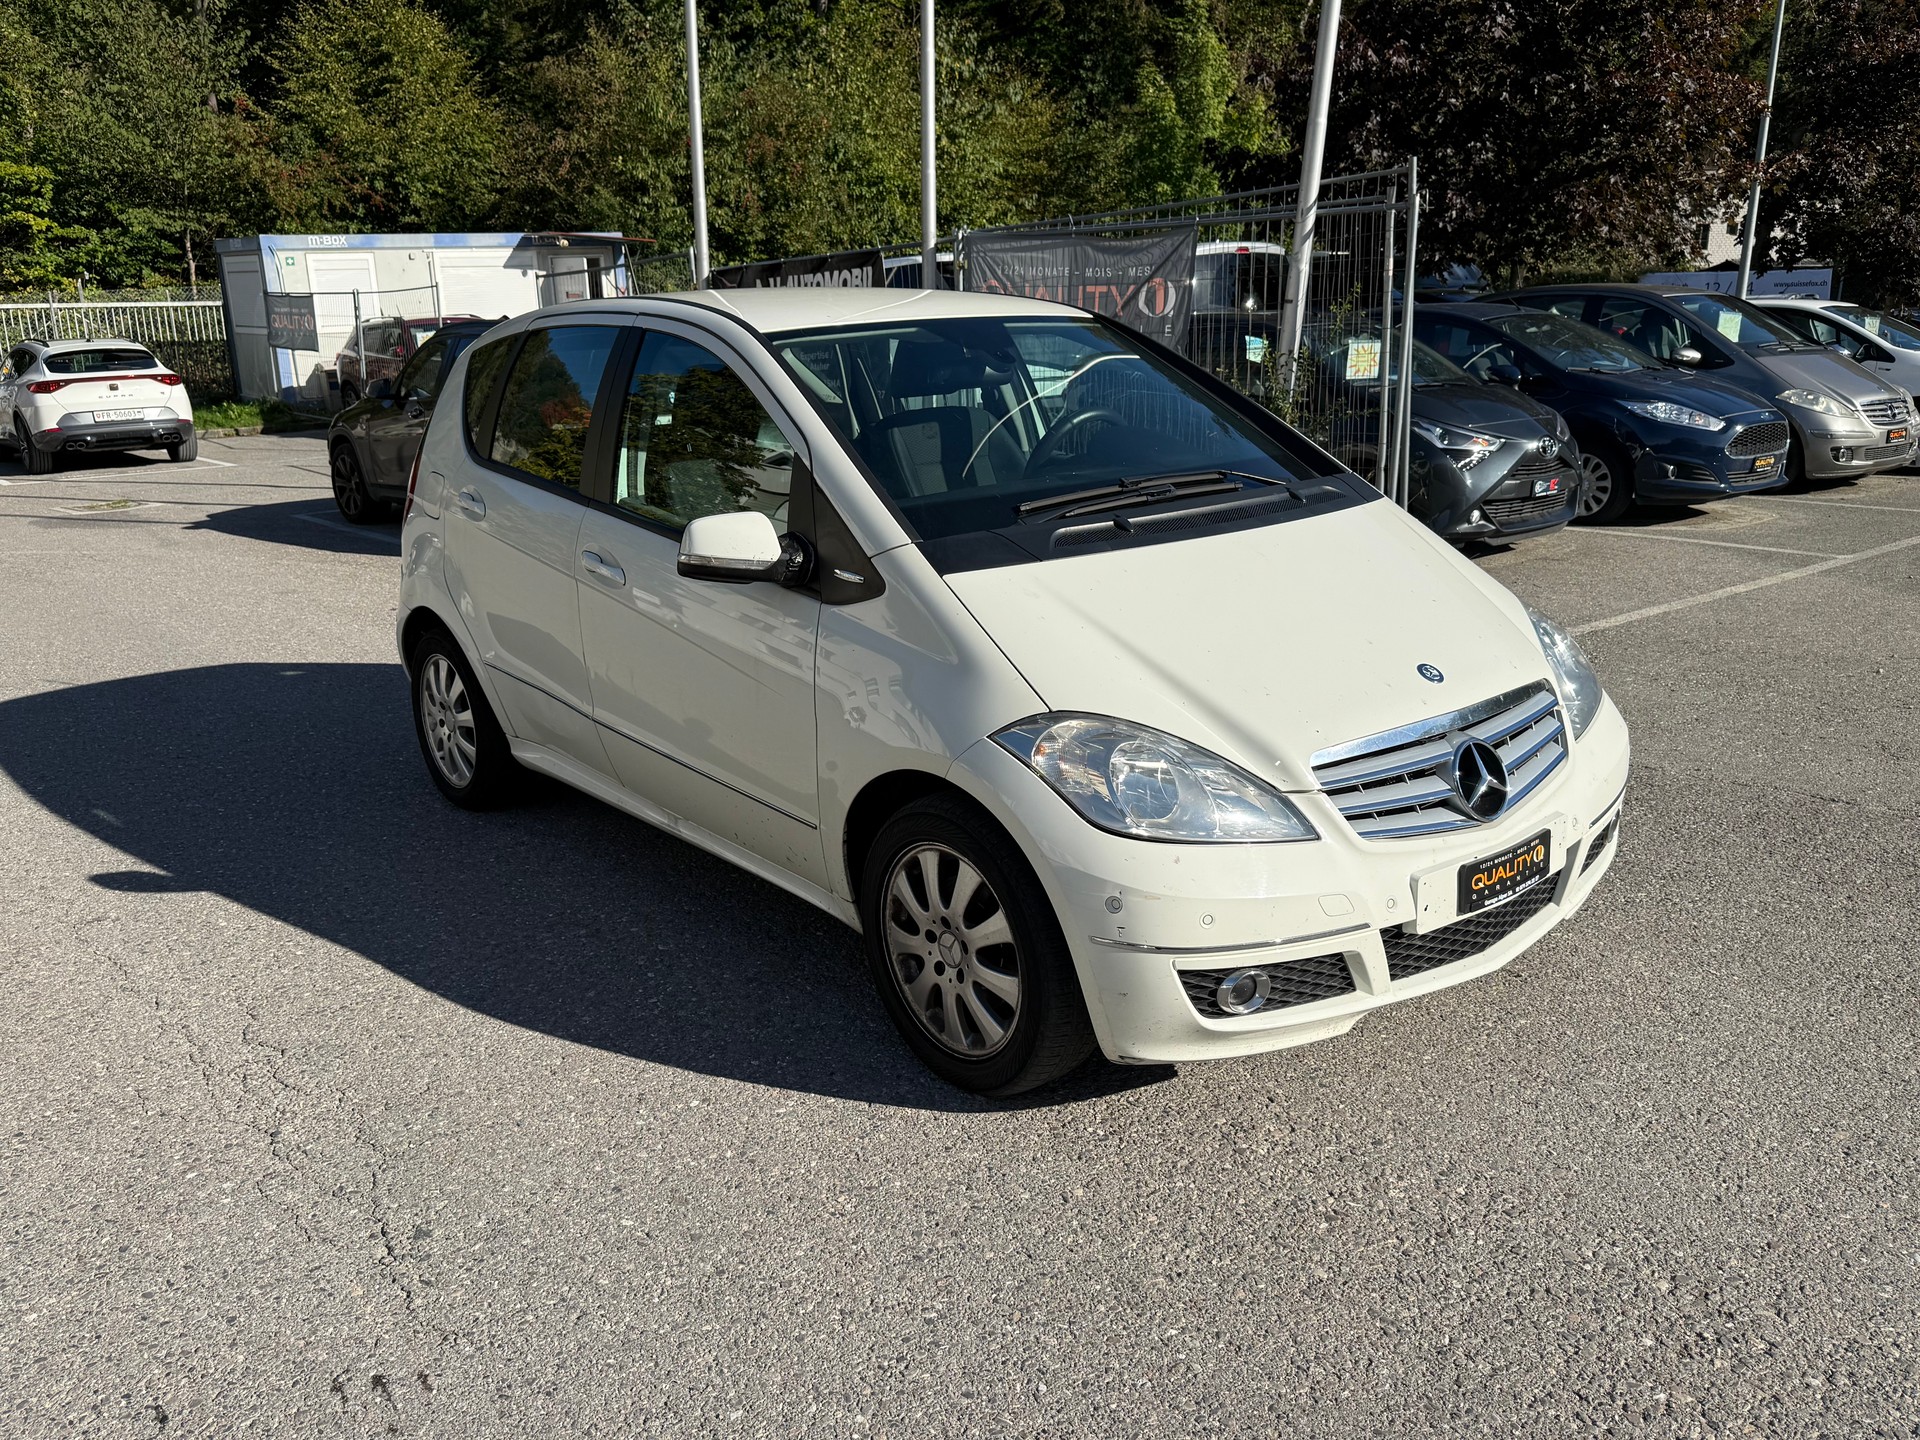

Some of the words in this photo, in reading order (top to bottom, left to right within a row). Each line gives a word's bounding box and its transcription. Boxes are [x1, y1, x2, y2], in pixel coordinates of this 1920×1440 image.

[1029, 266, 1070, 277] MONATE
[1085, 267, 1112, 277] MOIS
[271, 314, 304, 330] QUALITY
[1471, 850, 1533, 891] QUALITY
[1472, 861, 1544, 900] GARANTIE
